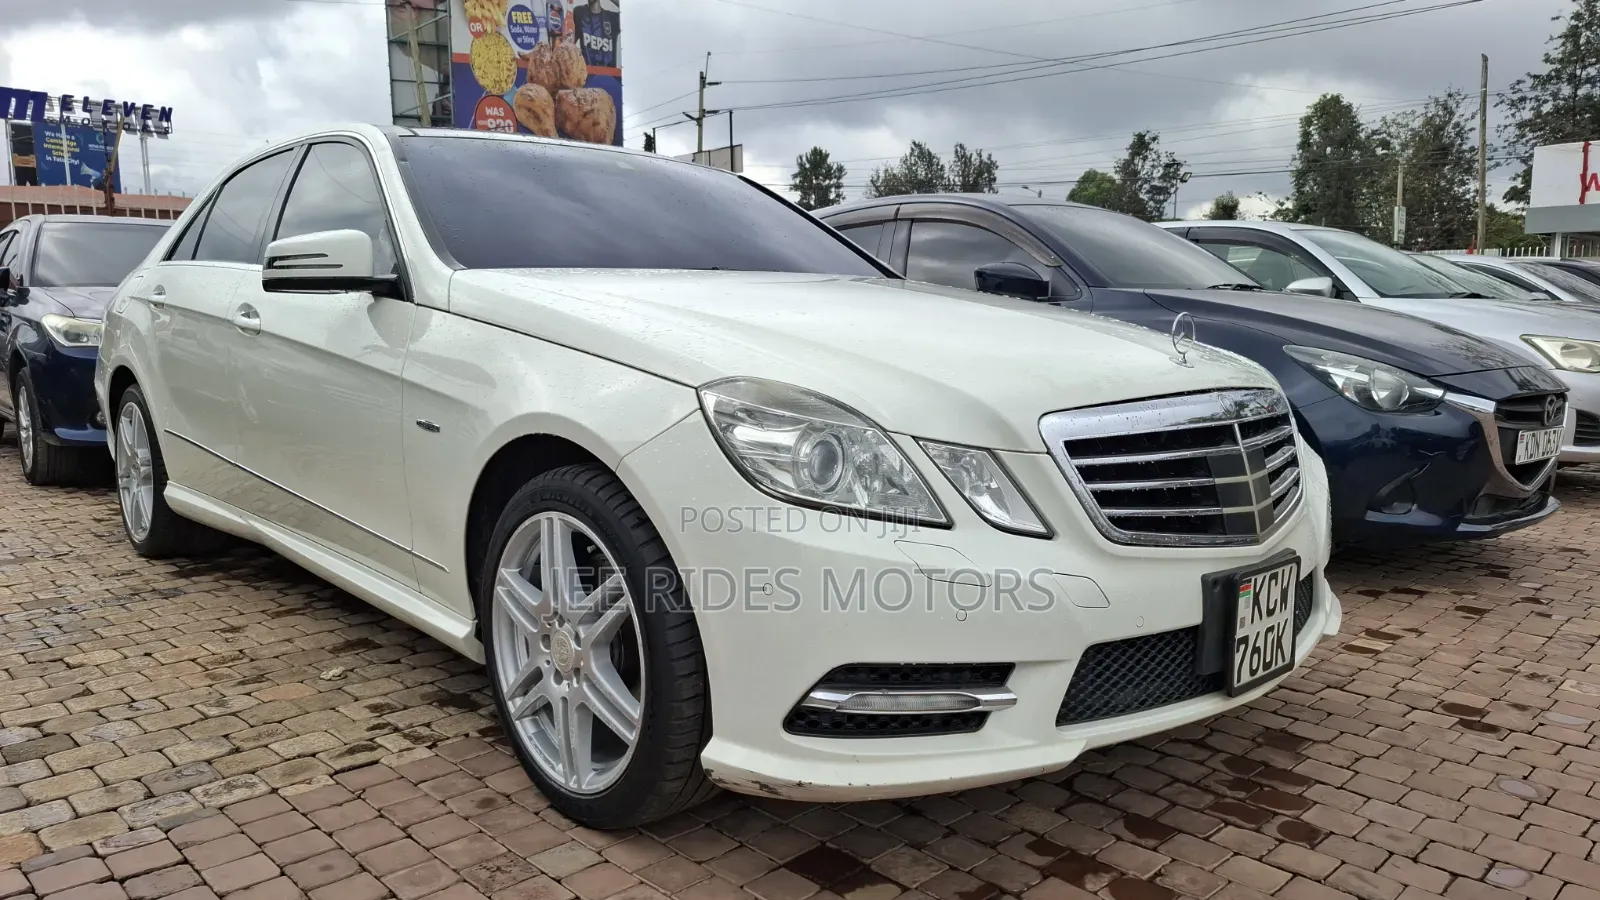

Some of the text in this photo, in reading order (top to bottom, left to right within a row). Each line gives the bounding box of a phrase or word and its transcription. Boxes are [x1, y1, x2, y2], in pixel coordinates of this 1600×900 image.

[470, 22, 484, 32] OR
[511, 11, 533, 24] FREE
[583, 32, 613, 52] PEPSI
[61, 94, 173, 122] ELEVEN
[485, 106, 505, 117] WAS
[1250, 565, 1294, 625] KCW
[1236, 617, 1289, 684] 760K
